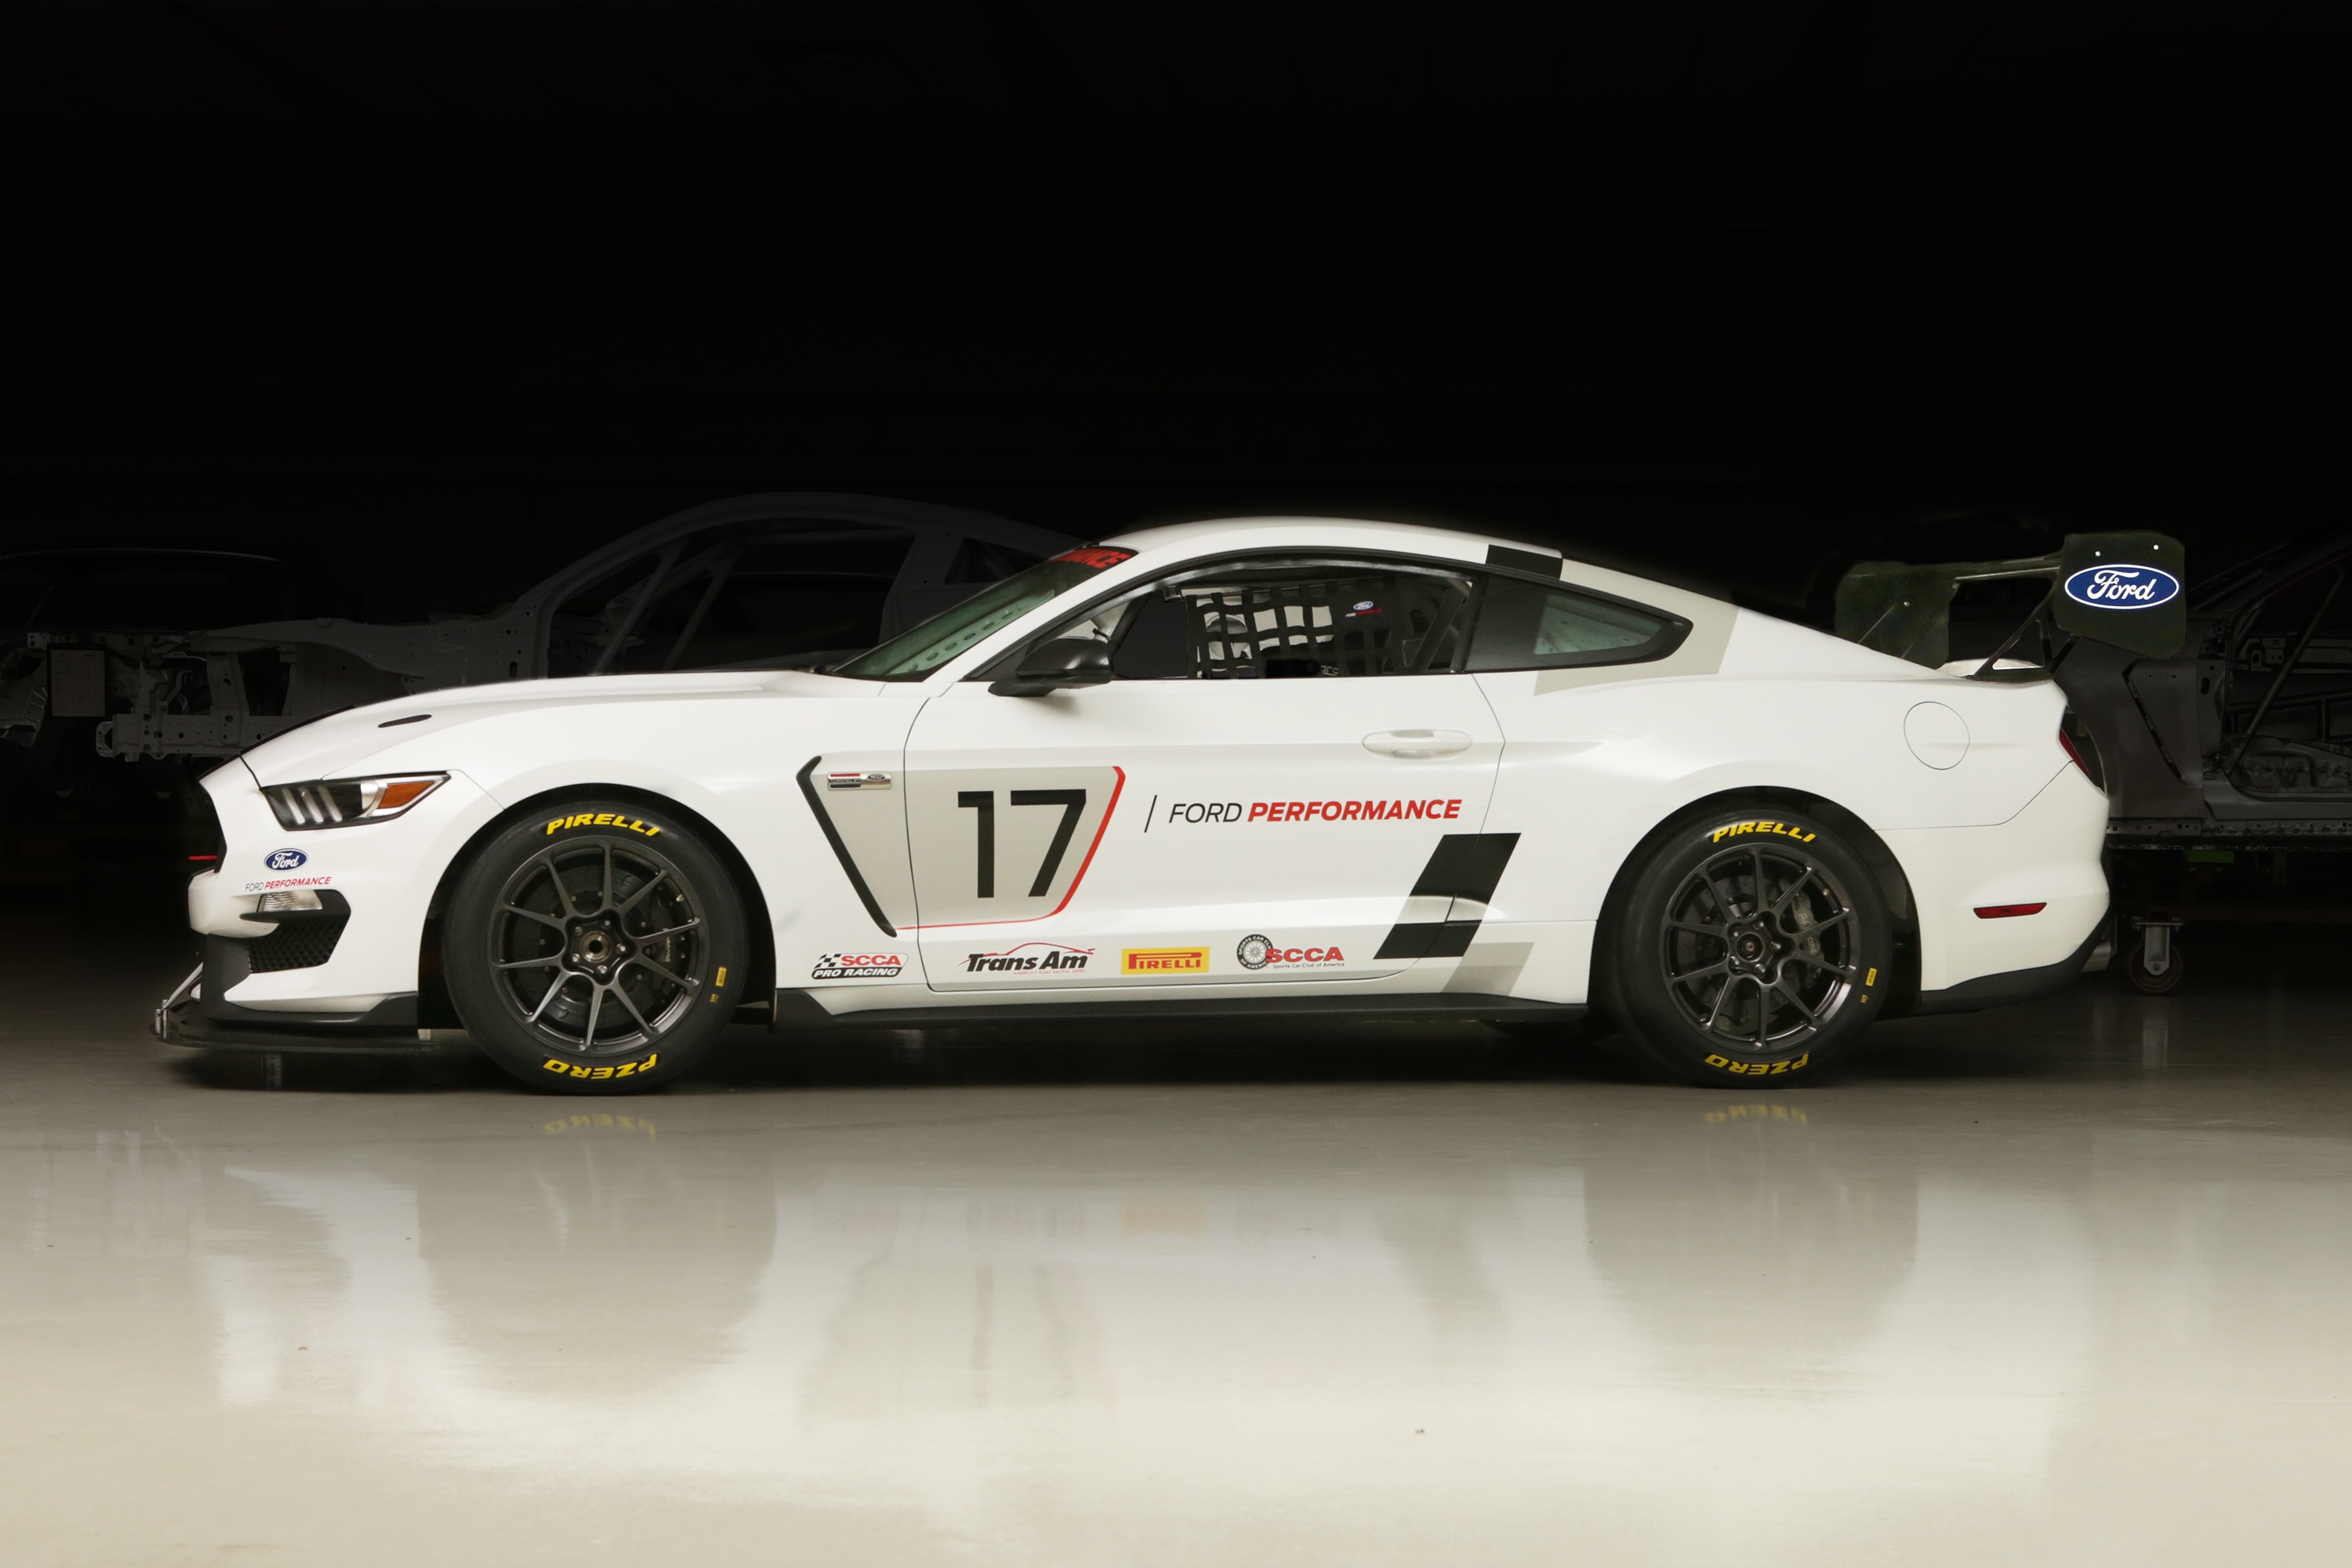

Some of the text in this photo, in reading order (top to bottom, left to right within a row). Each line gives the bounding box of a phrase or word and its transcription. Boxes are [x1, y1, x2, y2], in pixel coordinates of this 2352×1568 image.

[2086, 569, 2158, 601] Ford
[1169, 799, 1462, 823] FORD PERFORMANCE
[546, 813, 661, 837] PIRELLI
[1712, 821, 1817, 843] PIRELLI
[958, 789, 1087, 898] 17
[271, 852, 300, 869] Ford
[245, 877, 332, 891] FORD PERFORMANCE
[841, 955, 902, 967] SCCA
[967, 951, 1088, 972] Trans Am
[1128, 952, 1202, 969] PIRELLI
[1247, 960, 1268, 969] AMERIC
[1265, 946, 1345, 964] SCCA
[813, 967, 898, 978] PRO RACING
[543, 1053, 658, 1080] PZERO
[1704, 1053, 1809, 1075] PZERO
